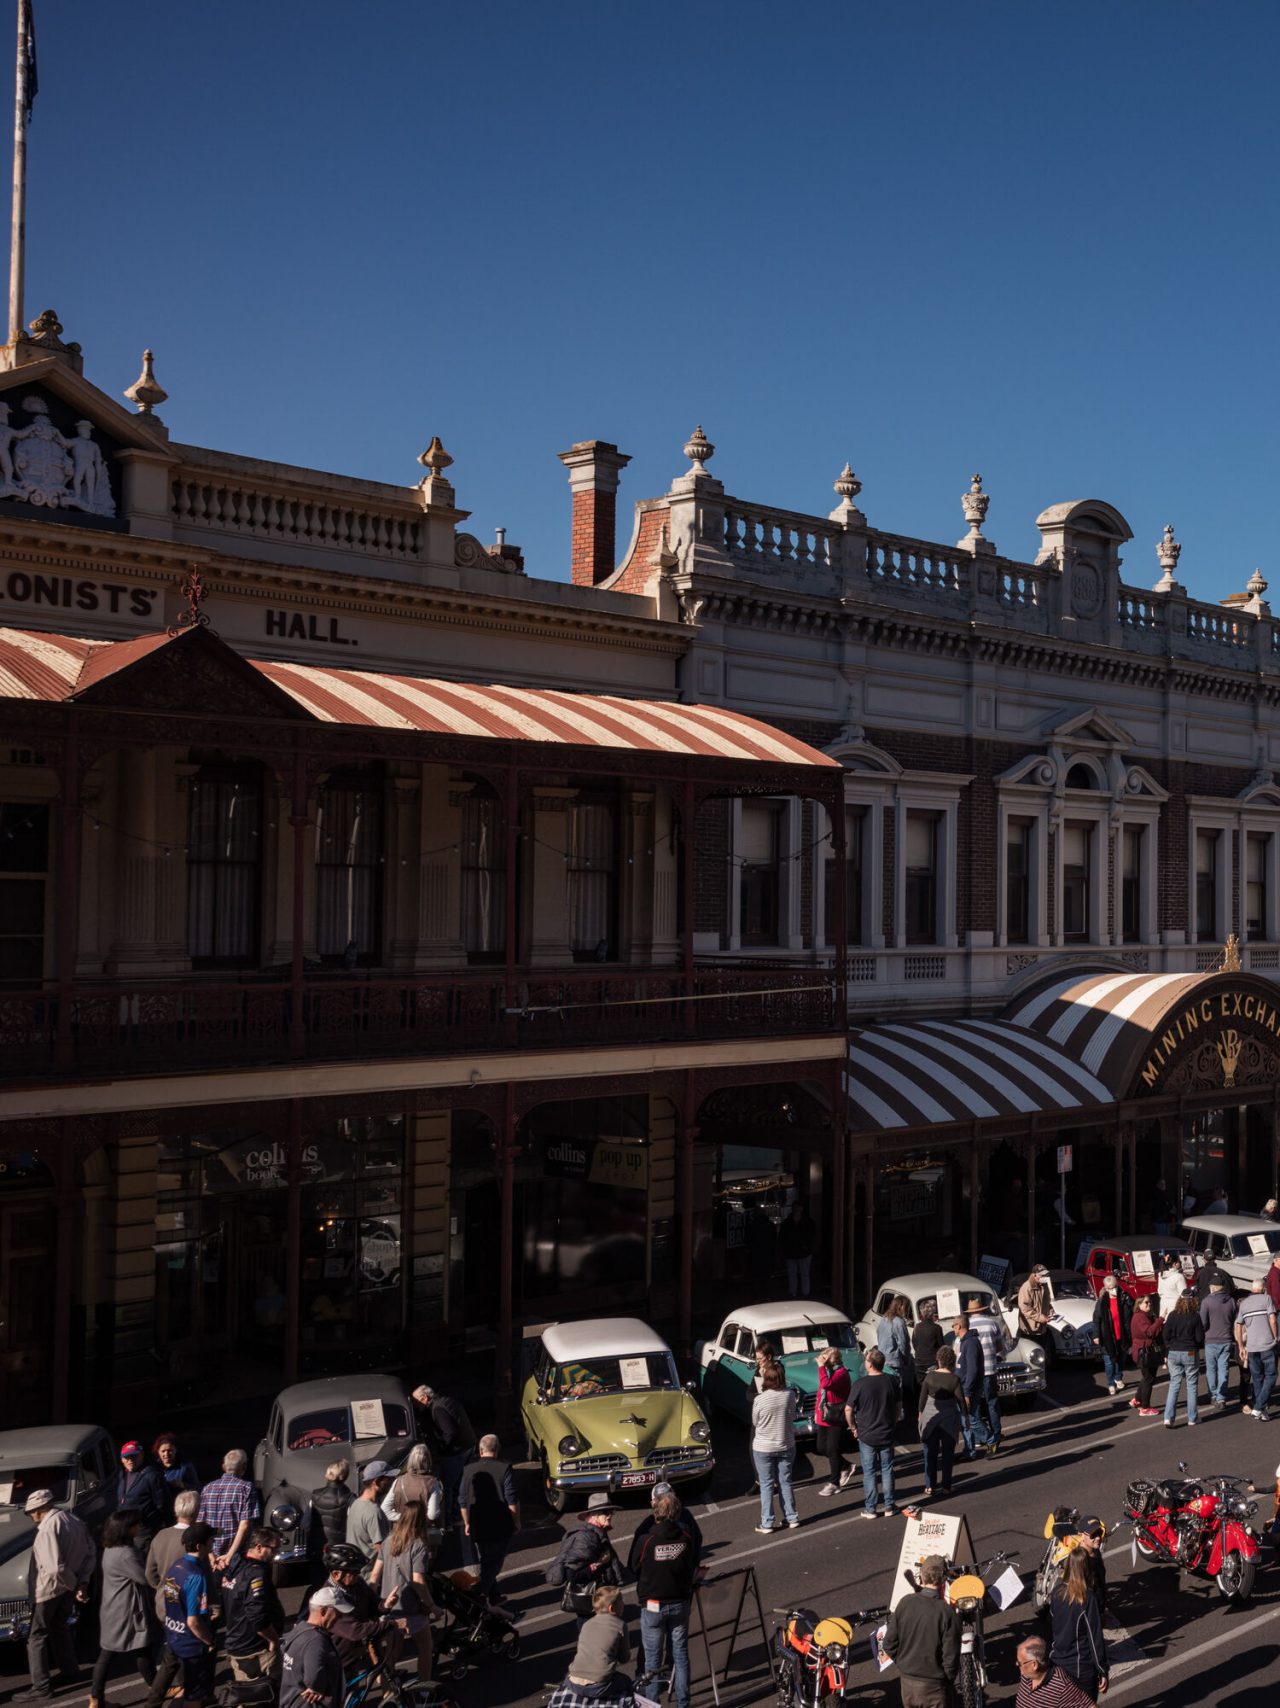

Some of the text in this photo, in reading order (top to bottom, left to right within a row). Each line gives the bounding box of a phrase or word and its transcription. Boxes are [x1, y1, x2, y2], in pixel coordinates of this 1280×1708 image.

[0, 573, 358, 645] ONISTS' HALL.
[1140, 999, 1213, 1088] MINING
[600, 1150, 642, 1171] pop up
